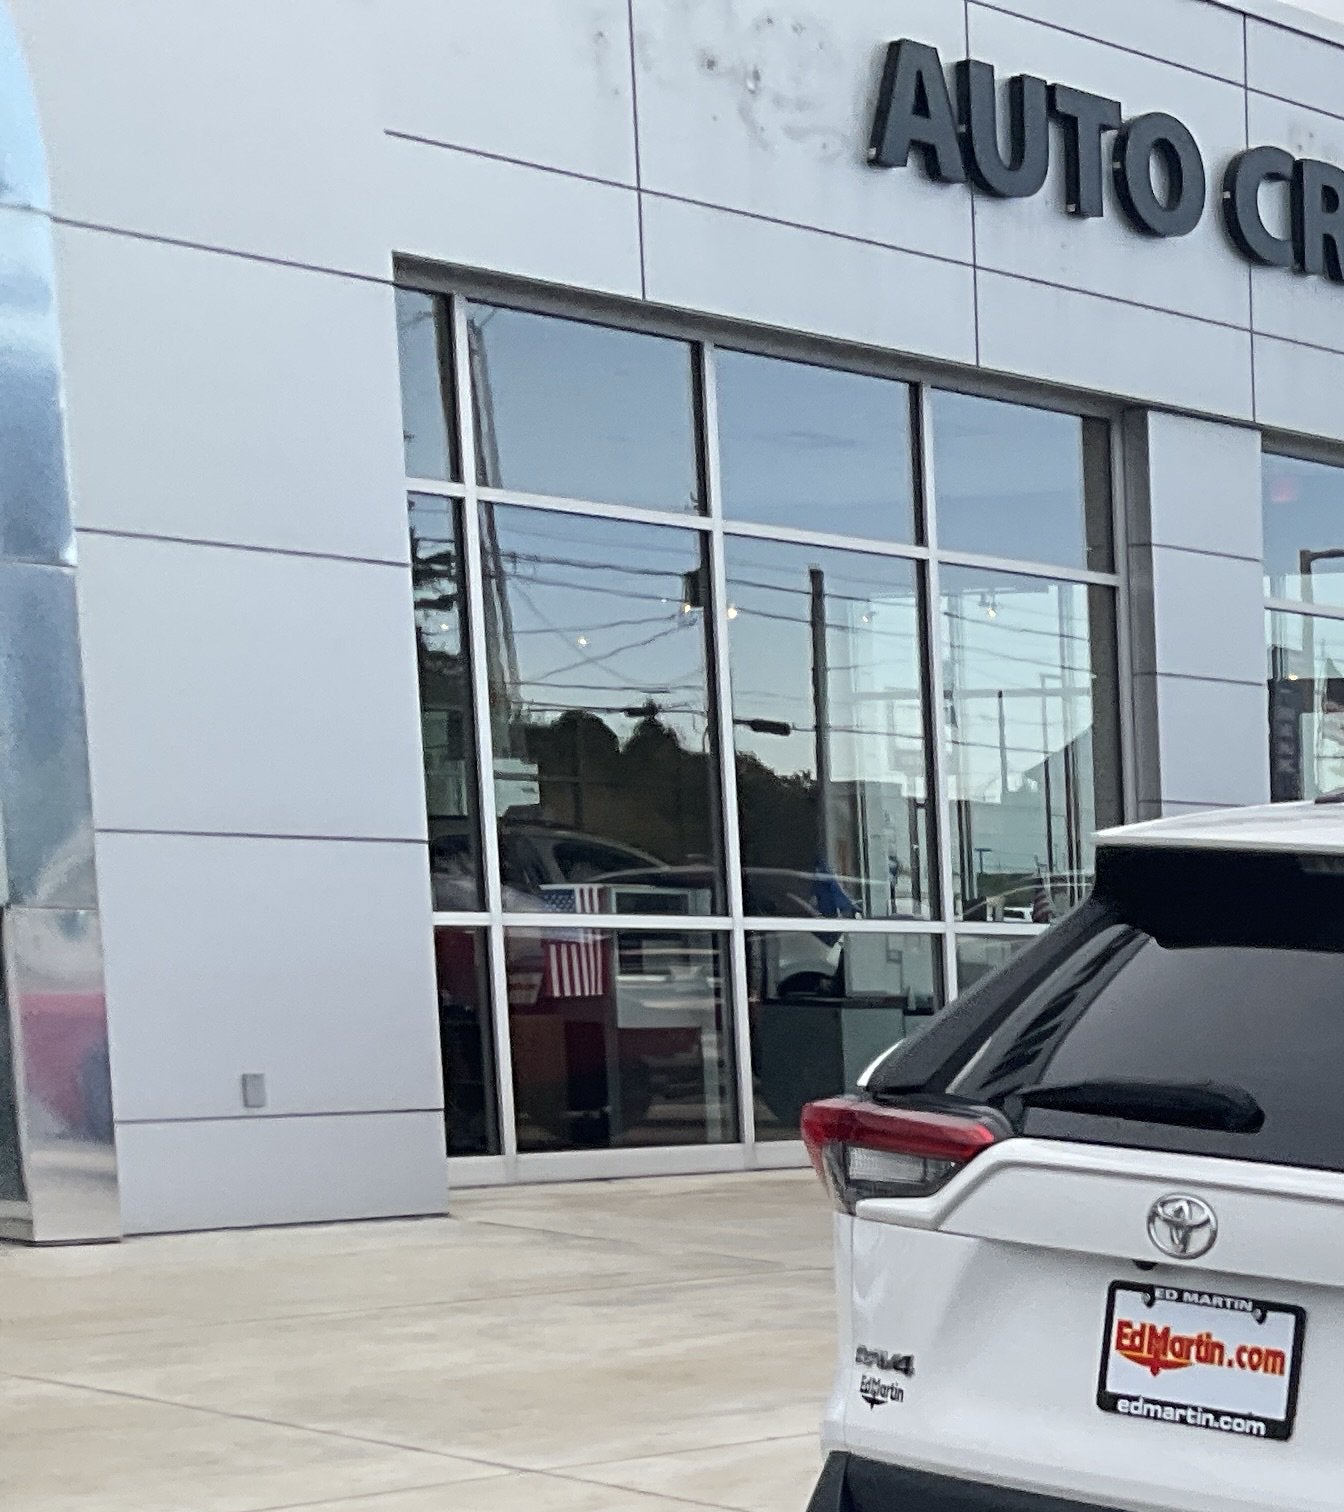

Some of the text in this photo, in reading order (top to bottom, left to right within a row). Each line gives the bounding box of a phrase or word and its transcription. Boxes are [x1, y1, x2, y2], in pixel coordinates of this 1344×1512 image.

[868, 39, 1205, 237] AUTO
[1154, 1287, 1253, 1312] ED MARTIN
[1115, 1318, 1286, 1377] EdMartin.com
[1116, 1397, 1267, 1436] edmartin.com
